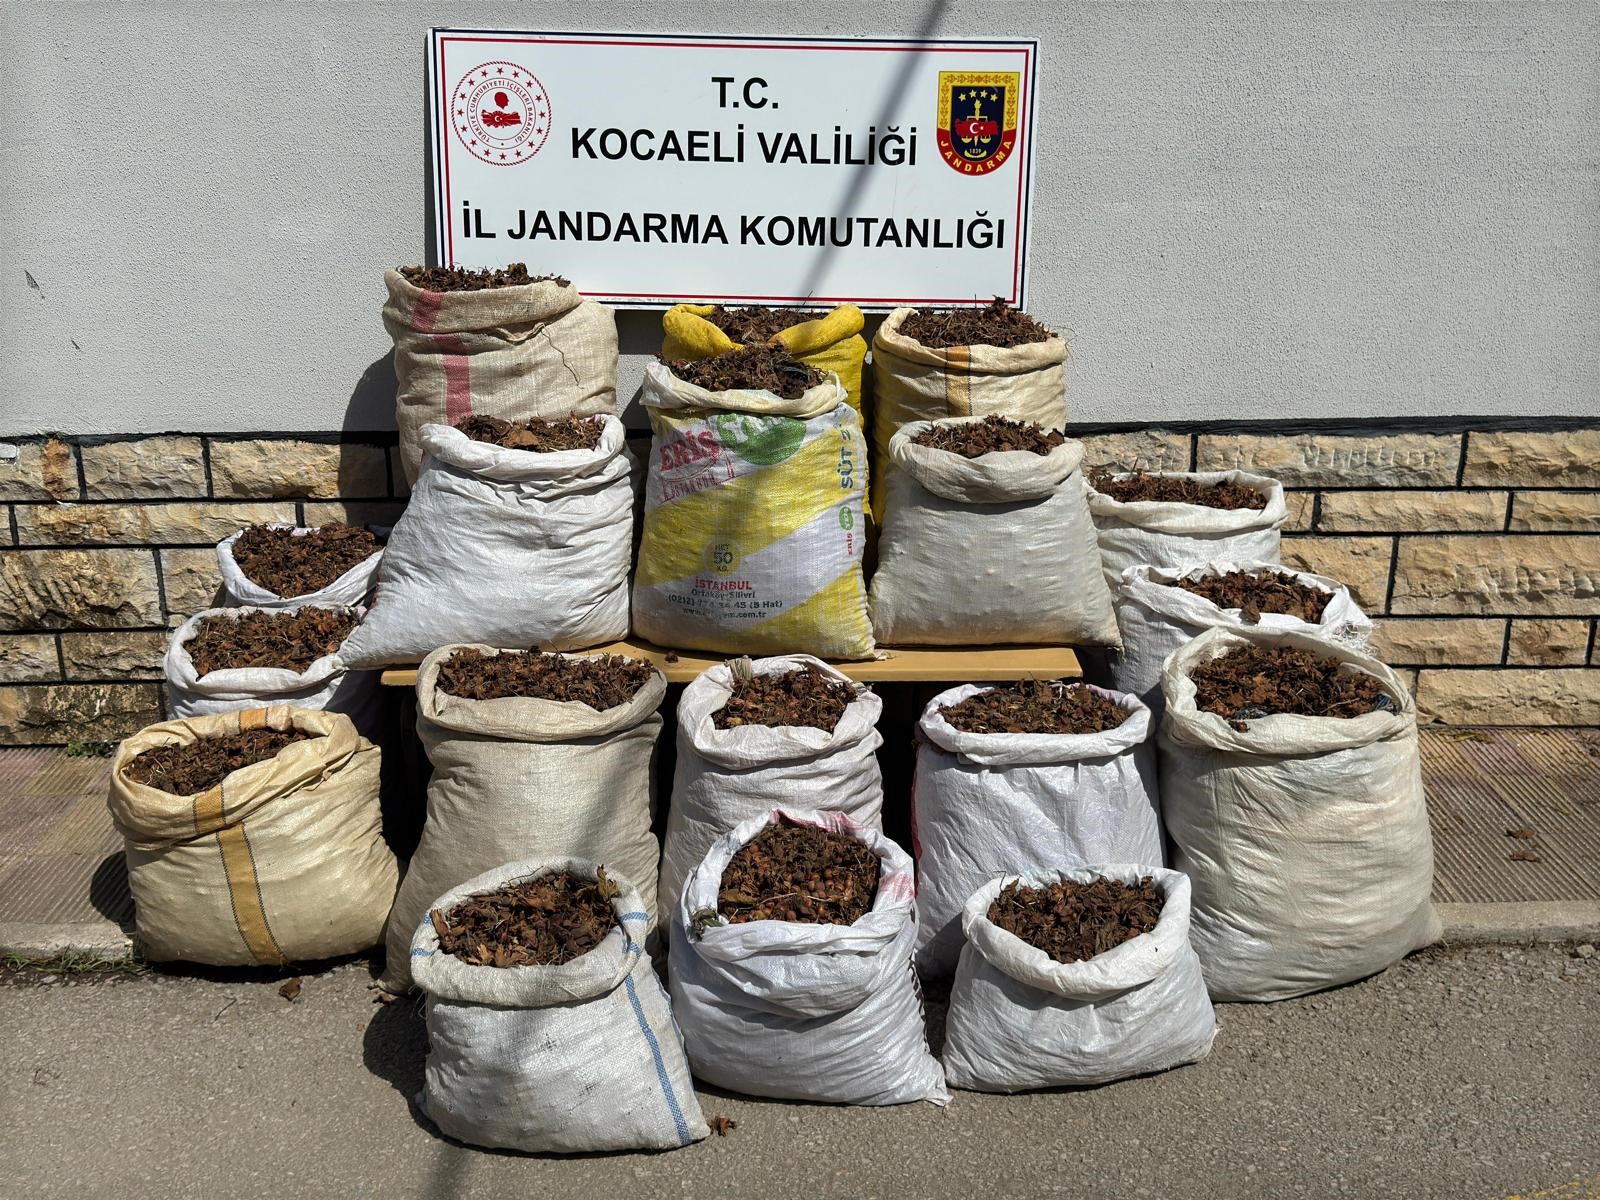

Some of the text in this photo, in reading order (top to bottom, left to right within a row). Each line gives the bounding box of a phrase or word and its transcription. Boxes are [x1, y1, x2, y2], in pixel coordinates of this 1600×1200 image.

[711, 77, 779, 109] T.C.
[571, 124, 917, 166] KOCAELİ VALİLİĞİ
[940, 140, 1012, 173] JANDARMA
[462, 200, 1005, 249] İL JANDARMA KOMUTANLIĞI
[837, 447, 853, 488] SÜT
[714, 552, 733, 564] 50
[695, 579, 753, 591] İSTANBUL
